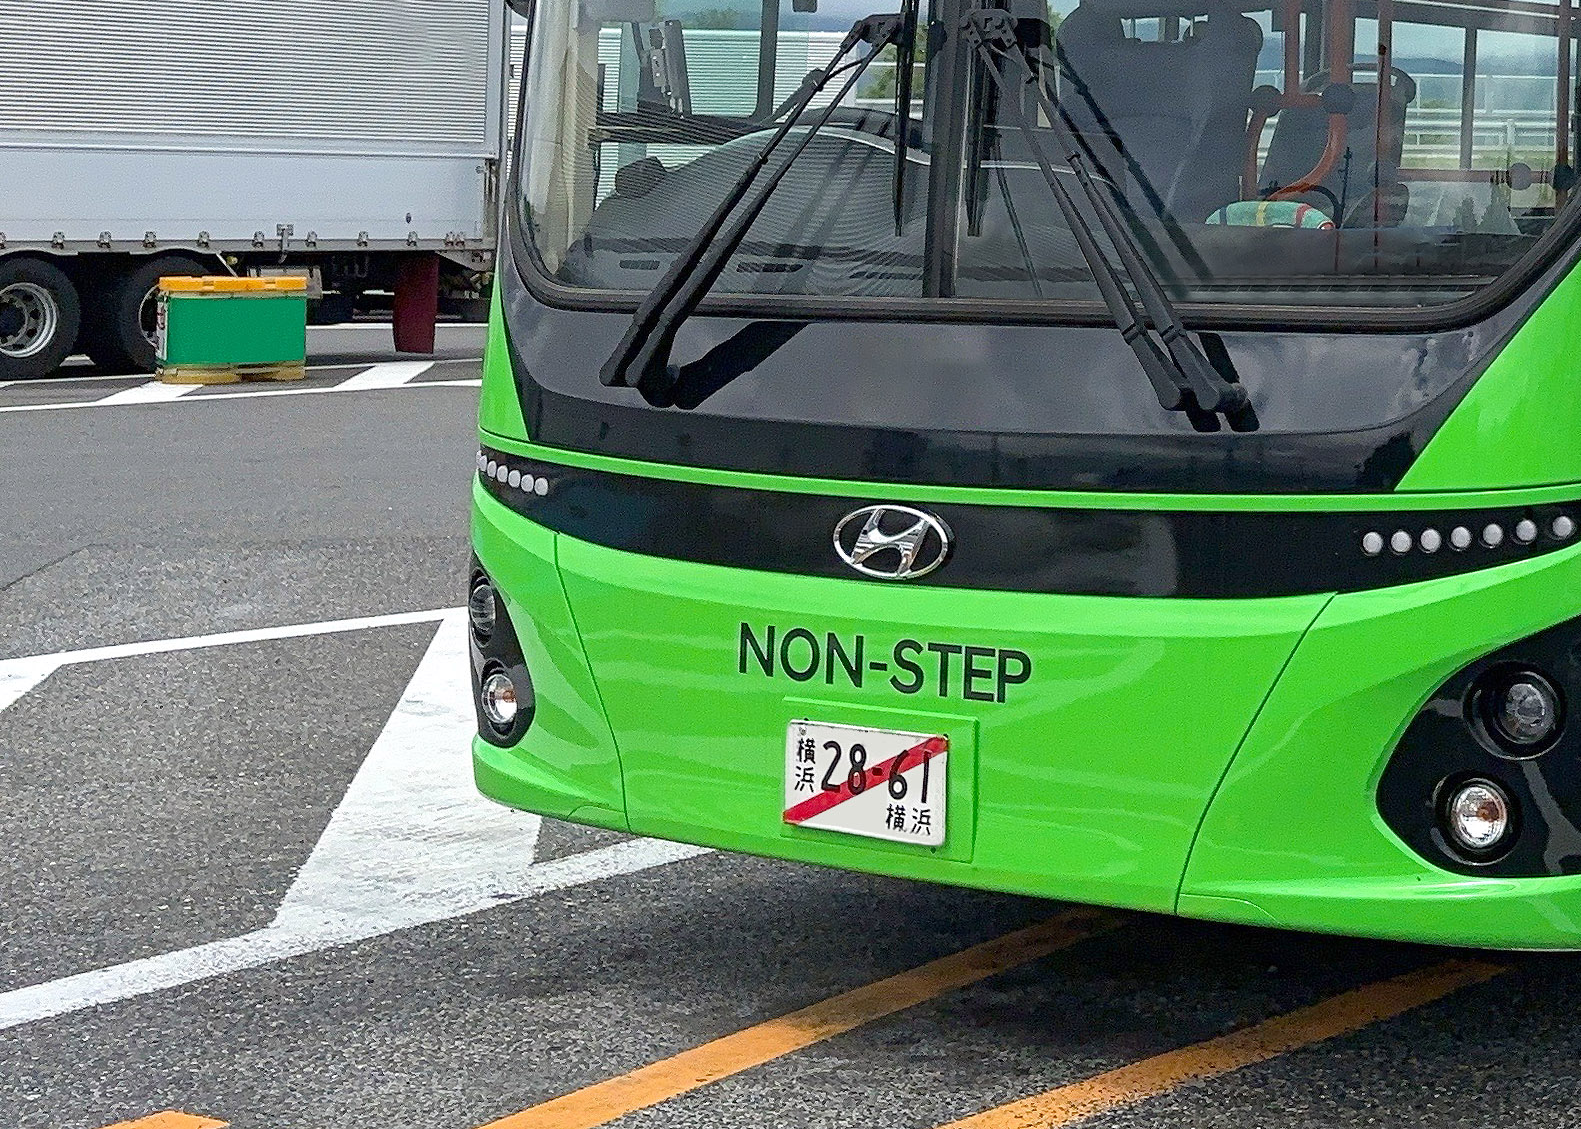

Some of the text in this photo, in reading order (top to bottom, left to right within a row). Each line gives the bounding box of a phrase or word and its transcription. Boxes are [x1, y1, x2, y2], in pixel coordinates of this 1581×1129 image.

[738, 621, 1032, 704] NON-STEP
[794, 737, 816, 793] 横浜
[821, 740, 932, 804] 28-61
[885, 803, 932, 836] 横浜
